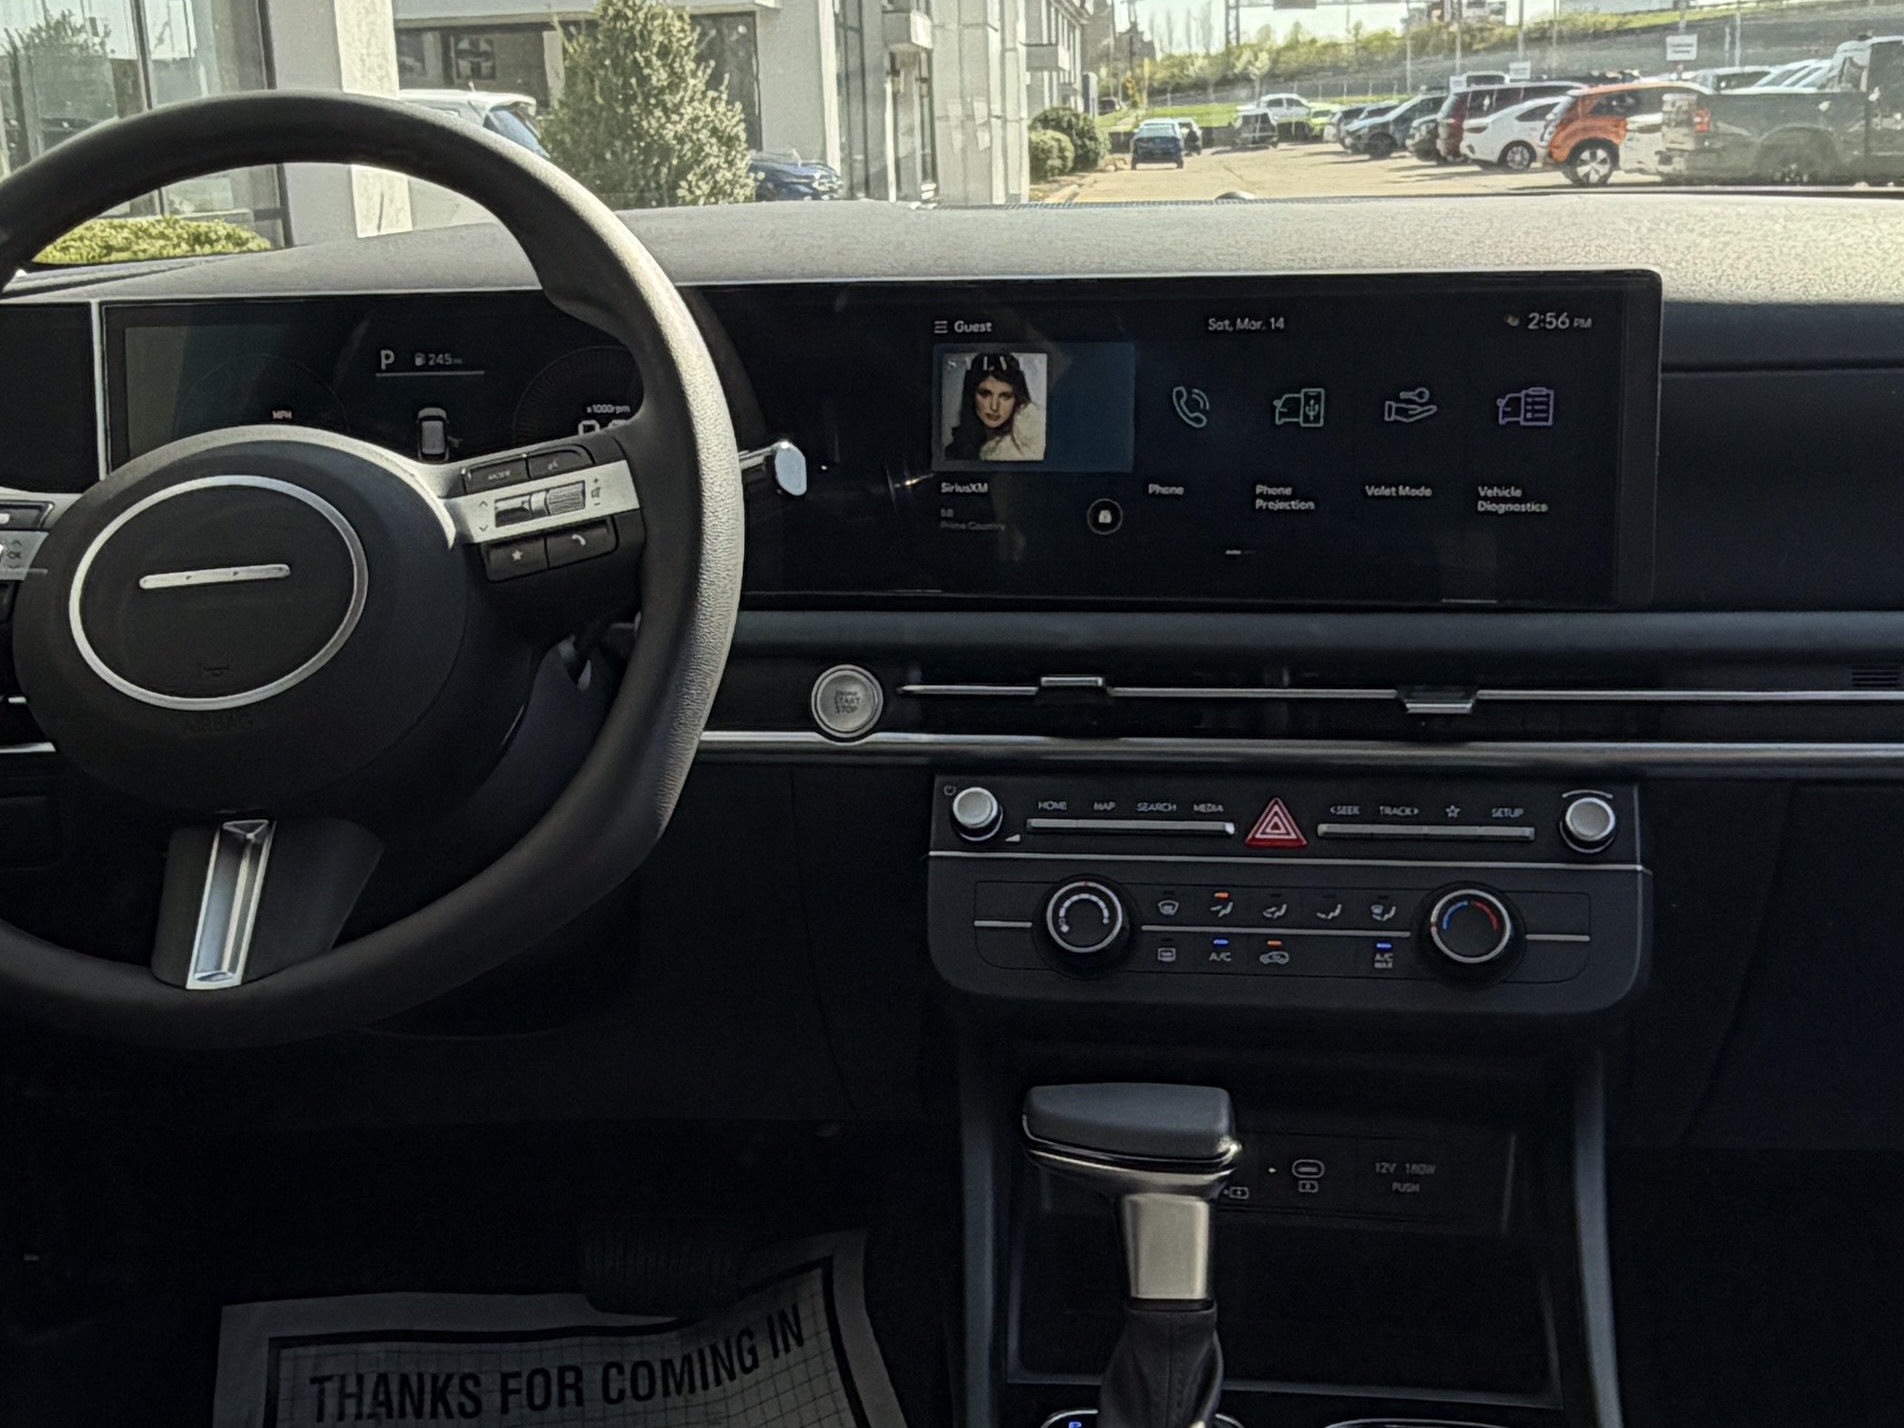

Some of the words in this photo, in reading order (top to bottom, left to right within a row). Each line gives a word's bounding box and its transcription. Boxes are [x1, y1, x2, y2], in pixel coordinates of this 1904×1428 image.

[954, 320, 993, 335] Guest
[1206, 317, 1235, 335] Sat,
[1236, 316, 1267, 332] Mar.
[1269, 316, 1286, 331] 14
[1526, 312, 1571, 330] 2:56
[379, 349, 396, 371] P
[427, 352, 453, 367] 245
[940, 481, 989, 495] SiriusXM
[1148, 483, 1186, 497] Phone
[1256, 483, 1294, 497] Phone
[1364, 484, 1396, 499] Valet
[1398, 485, 1434, 499] Mode
[1476, 484, 1524, 499] Vehicle
[1256, 498, 1317, 513] Projection
[1476, 499, 1549, 515] Diagnostics
[1037, 801, 1068, 812] HOME
[1092, 801, 1117, 812] MAP
[1135, 802, 1178, 813] SEARCH
[1192, 803, 1225, 814] MEDIA
[1490, 808, 1525, 819] SETUP
[1208, 951, 1232, 963] A/C
[309, 1370, 484, 1424] THANKS
[495, 1363, 586, 1416] FOR
[600, 1325, 761, 1407] COMING
[766, 1302, 806, 1359] IN
